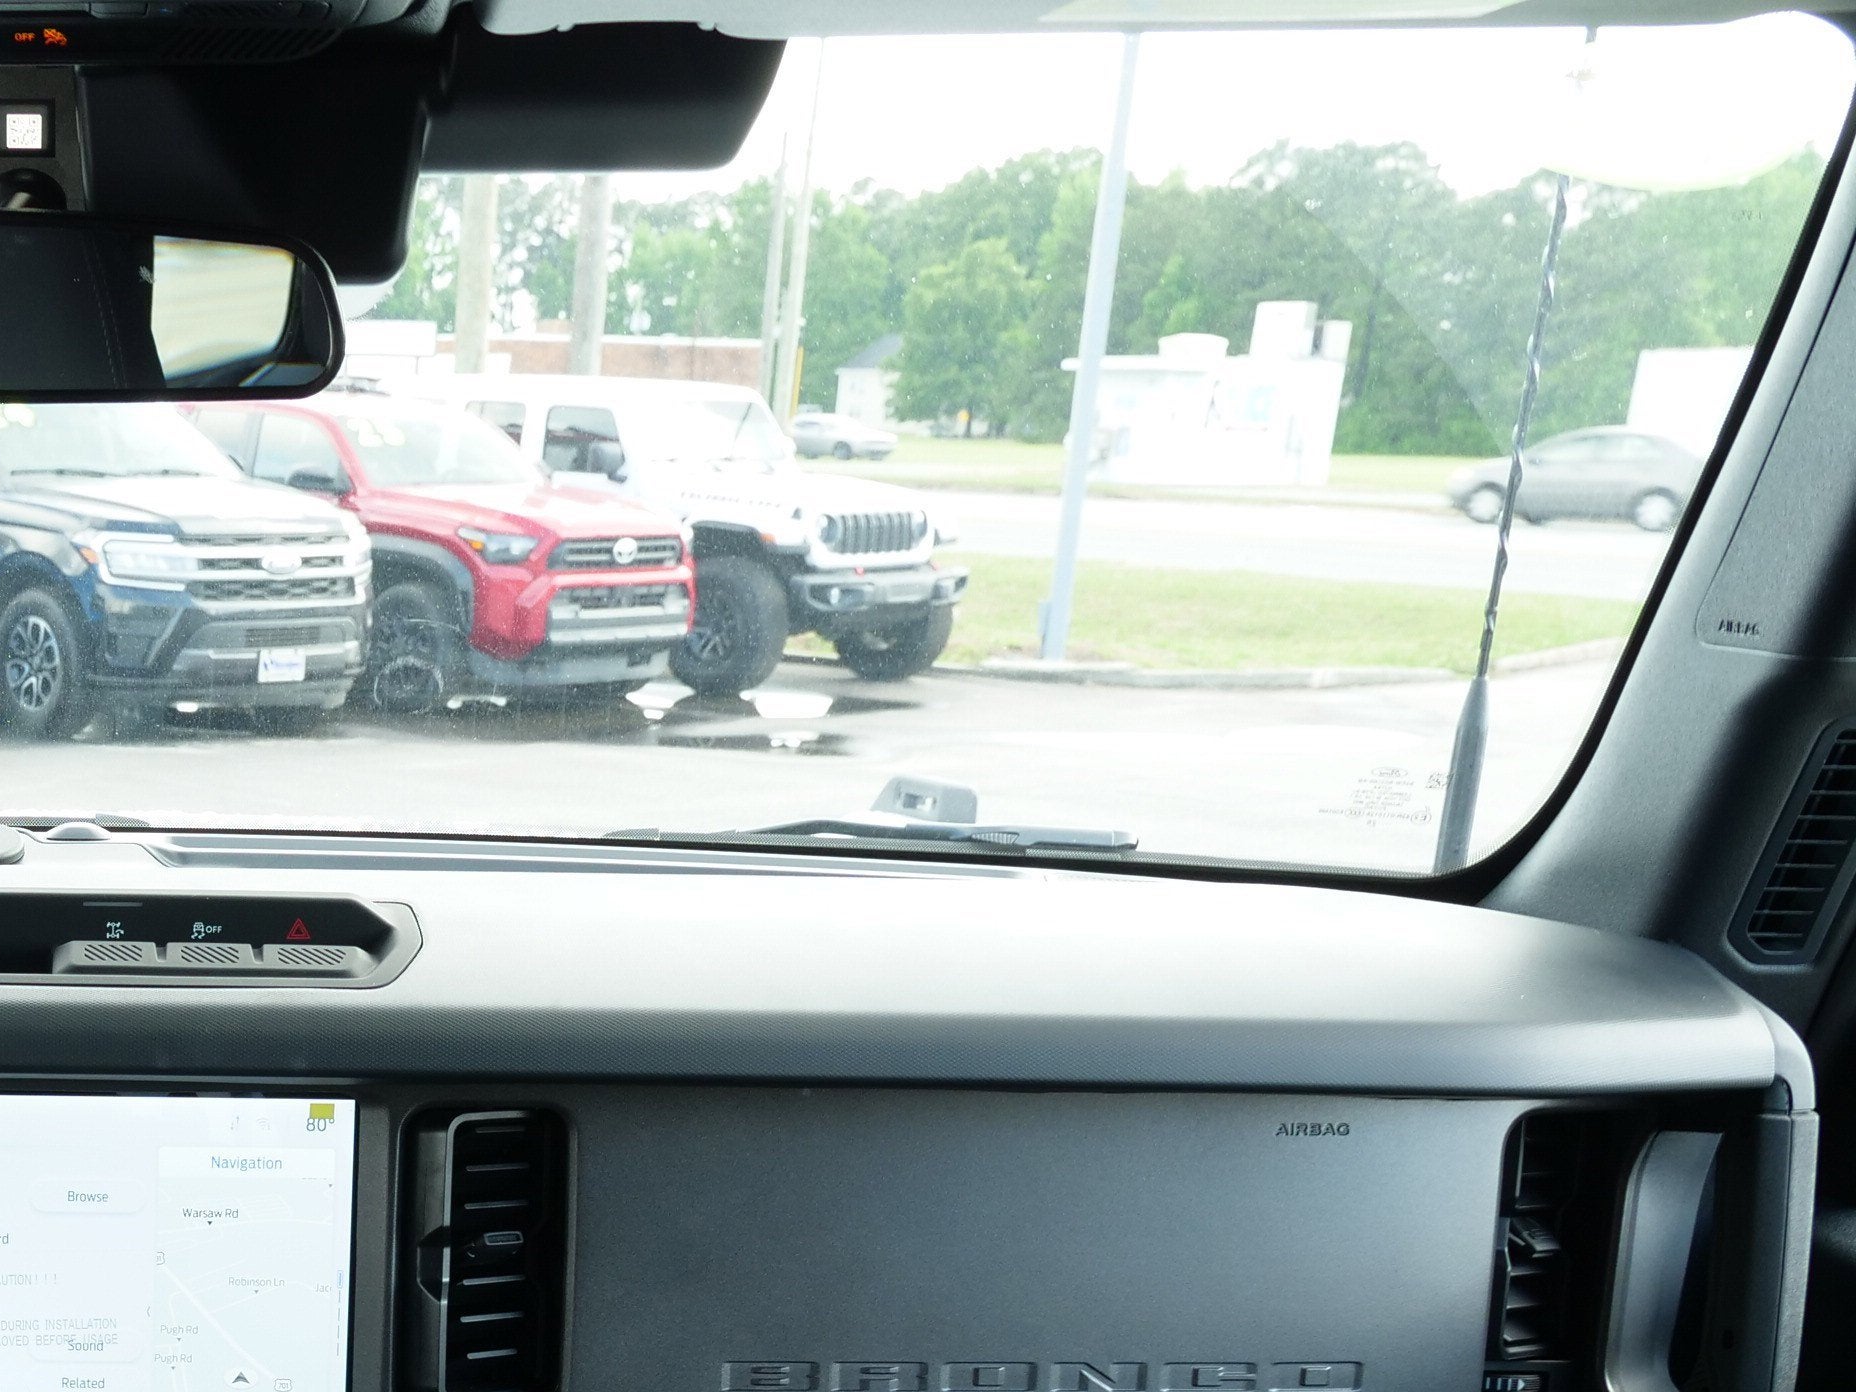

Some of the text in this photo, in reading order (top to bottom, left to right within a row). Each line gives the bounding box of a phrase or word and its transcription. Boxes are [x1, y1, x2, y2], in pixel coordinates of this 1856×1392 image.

[14, 32, 36, 42] OFF
[205, 924, 223, 934] OFF
[1275, 1121, 1351, 1138] AIRBAG
[211, 1156, 283, 1171] Navigation
[67, 1190, 109, 1203] Browse
[182, 1208, 239, 1219] Warsaw Rd
[228, 1276, 285, 1287] Robinson Ln
[0, 1320, 40, 1332] DURING
[45, 1318, 117, 1331] INSTALLATION
[160, 1325, 198, 1336] Pugh Rd
[35, 1334, 77, 1346] BEFORE
[67, 1339, 104, 1352] Sound
[154, 1354, 193, 1365] Pugh Rd
[720, 1361, 1364, 1392] BRONCO
[61, 1377, 105, 1390] Related
